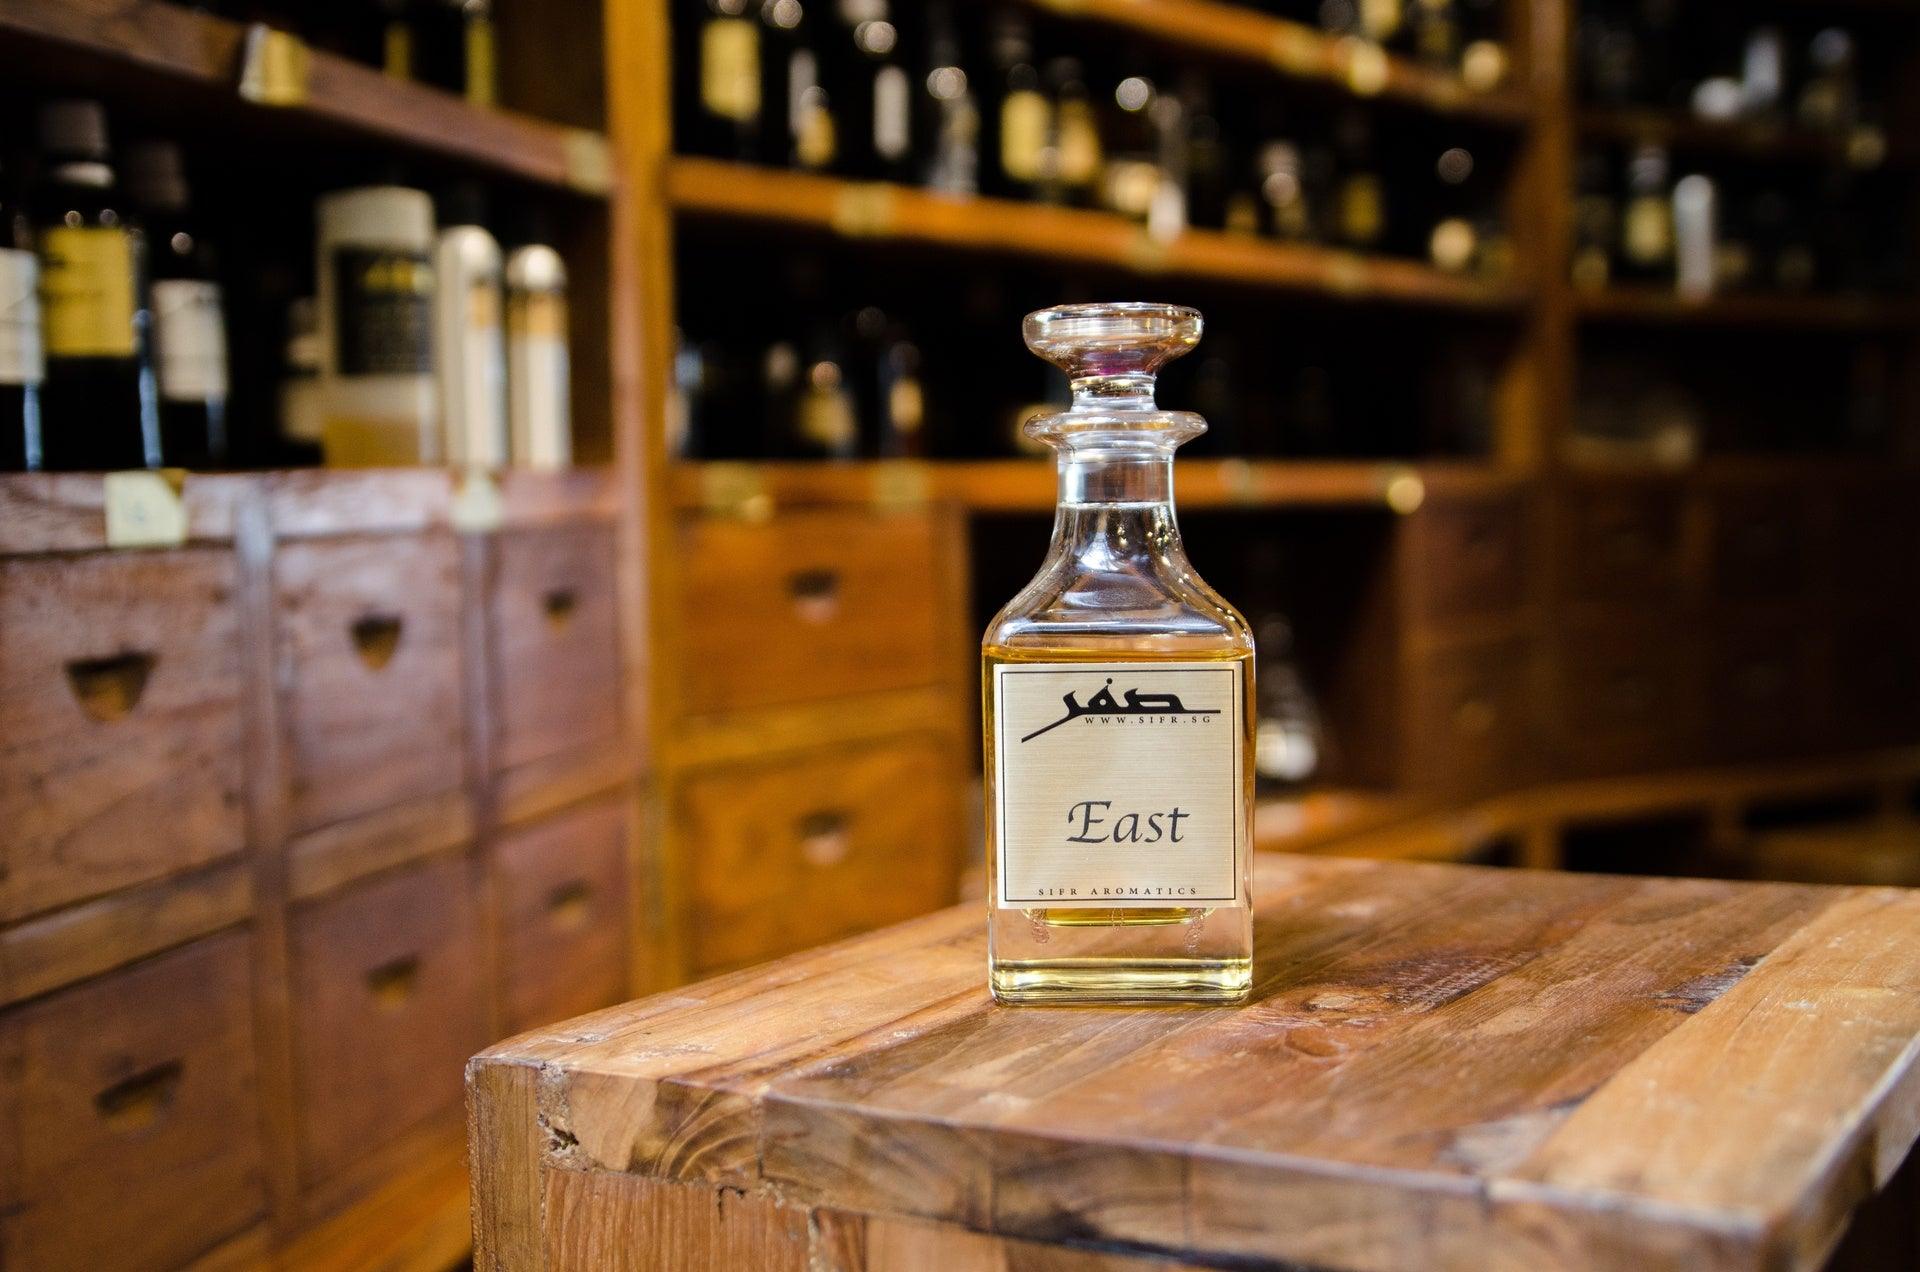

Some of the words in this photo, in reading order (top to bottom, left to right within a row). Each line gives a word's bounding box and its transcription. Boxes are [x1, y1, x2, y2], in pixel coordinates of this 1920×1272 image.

[1084, 715, 1212, 724] WWW.SIFR.SG
[1065, 800, 1191, 844] East
[1038, 887, 1079, 896] SIFR
[1090, 886, 1198, 896] AROMATICS
